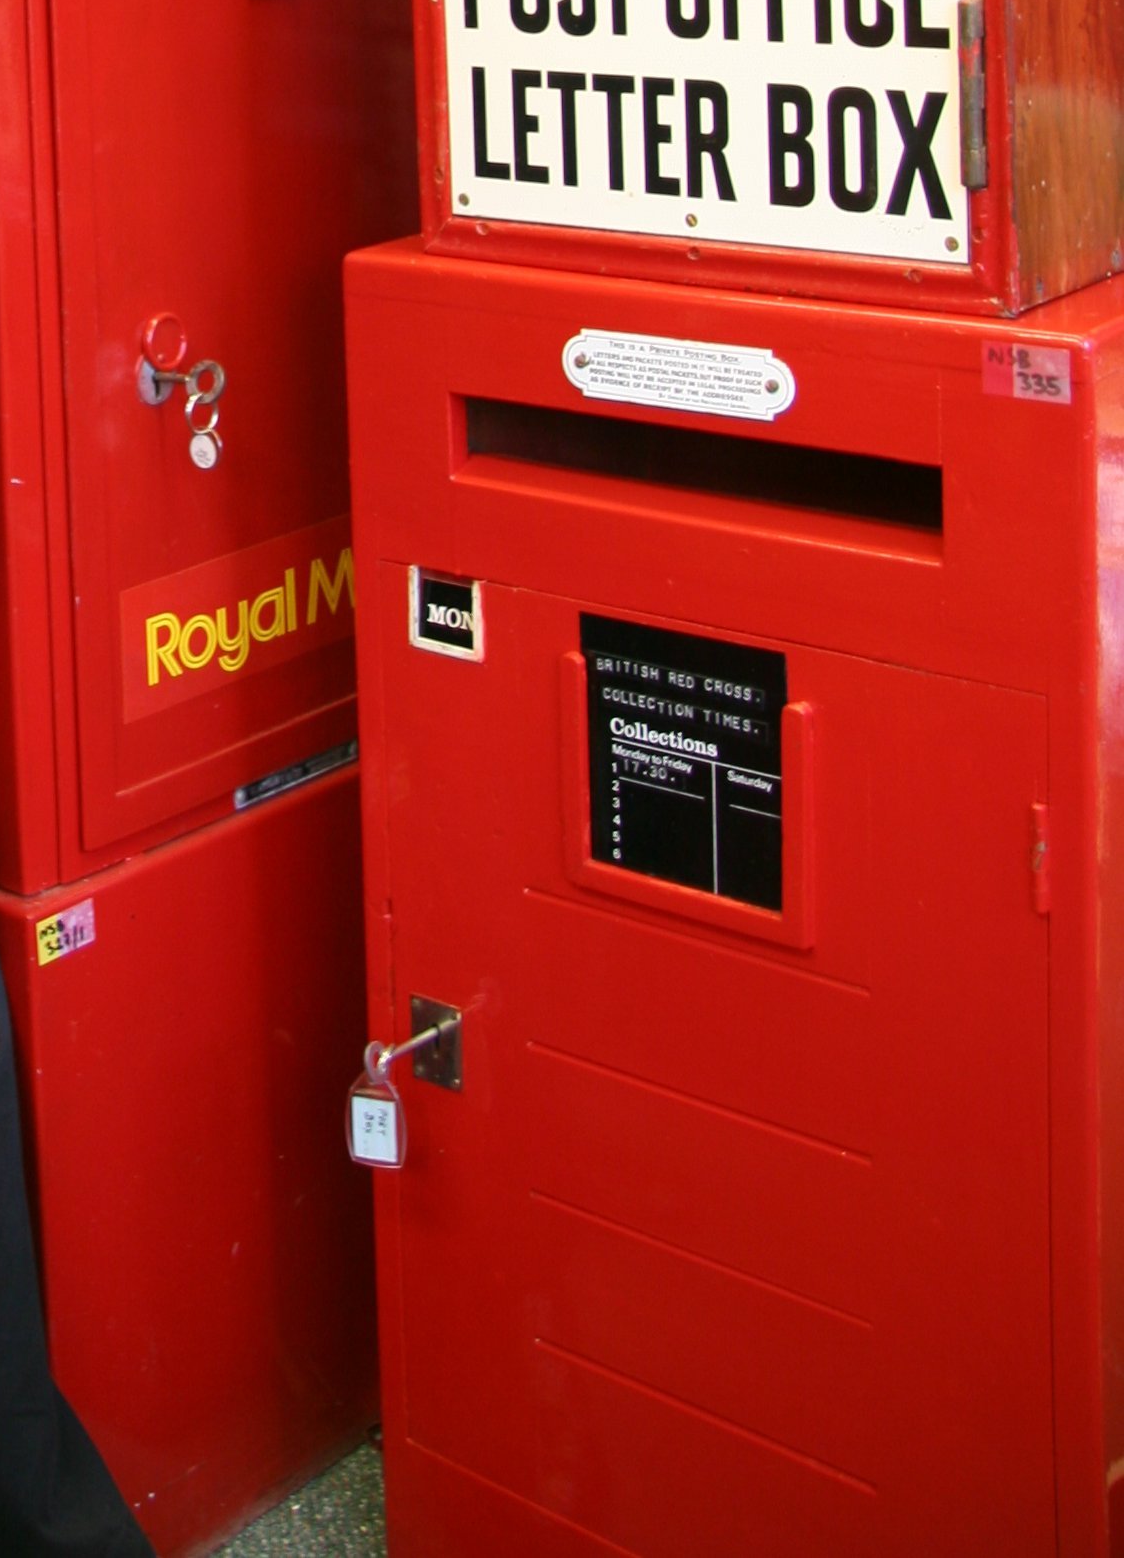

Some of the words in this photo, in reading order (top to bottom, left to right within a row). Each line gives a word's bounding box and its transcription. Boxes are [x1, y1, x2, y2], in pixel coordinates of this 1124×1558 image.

[471, 65, 738, 203] LETTER
[767, 83, 954, 221] BOX
[609, 340, 626, 350] THIS
[628, 343, 636, 351] IS
[649, 345, 680, 356] PRIVATE
[683, 349, 717, 361] POSTING
[593, 351, 620, 360] LETTERS
[635, 356, 663, 366] PACKETS
[663, 360, 690, 370] POSTED
[707, 365, 723, 374] WILL
[723, 366, 732, 375] BE
[733, 367, 763, 378] TREATED
[607, 361, 638, 371] RESPECTS
[638, 365, 647, 373] AS
[647, 367, 670, 376] POSTAL
[713, 375, 734, 383] PROOF
[744, 378, 763, 387] SUCH
[589, 368, 615, 377] POSTING
[616, 371, 631, 379] WILL
[657, 376, 687, 387] ACCEPTED
[697, 381, 716, 390] LEGAL
[718, 383, 762, 395] PROCEEDINGS
[590, 375, 599, 383] AS
[600, 377, 630, 388] EVIDENCE
[643, 382, 672, 393] RECEIPT
[687, 389, 700, 397] THE
[1016, 371, 1062, 397] 335
[145, 567, 298, 687] Royal
[426, 603, 474, 632] MON
[596, 657, 660, 681] BRITISH
[667, 671, 696, 690] RED
[704, 678, 762, 703] CROSS.
[602, 687, 694, 719] COLLECTION
[703, 708, 760, 734] TIMES.
[609, 716, 719, 758] Collections
[611, 743, 651, 763] Monday
[651, 754, 662, 766] to
[662, 755, 693, 774] Friday
[612, 762, 618, 773] 1
[611, 780, 620, 792] 2
[726, 769, 773, 793] Saturday
[612, 797, 621, 809] 3
[612, 814, 621, 826] 4
[612, 831, 621, 843] 5
[612, 848, 622, 860] 6
